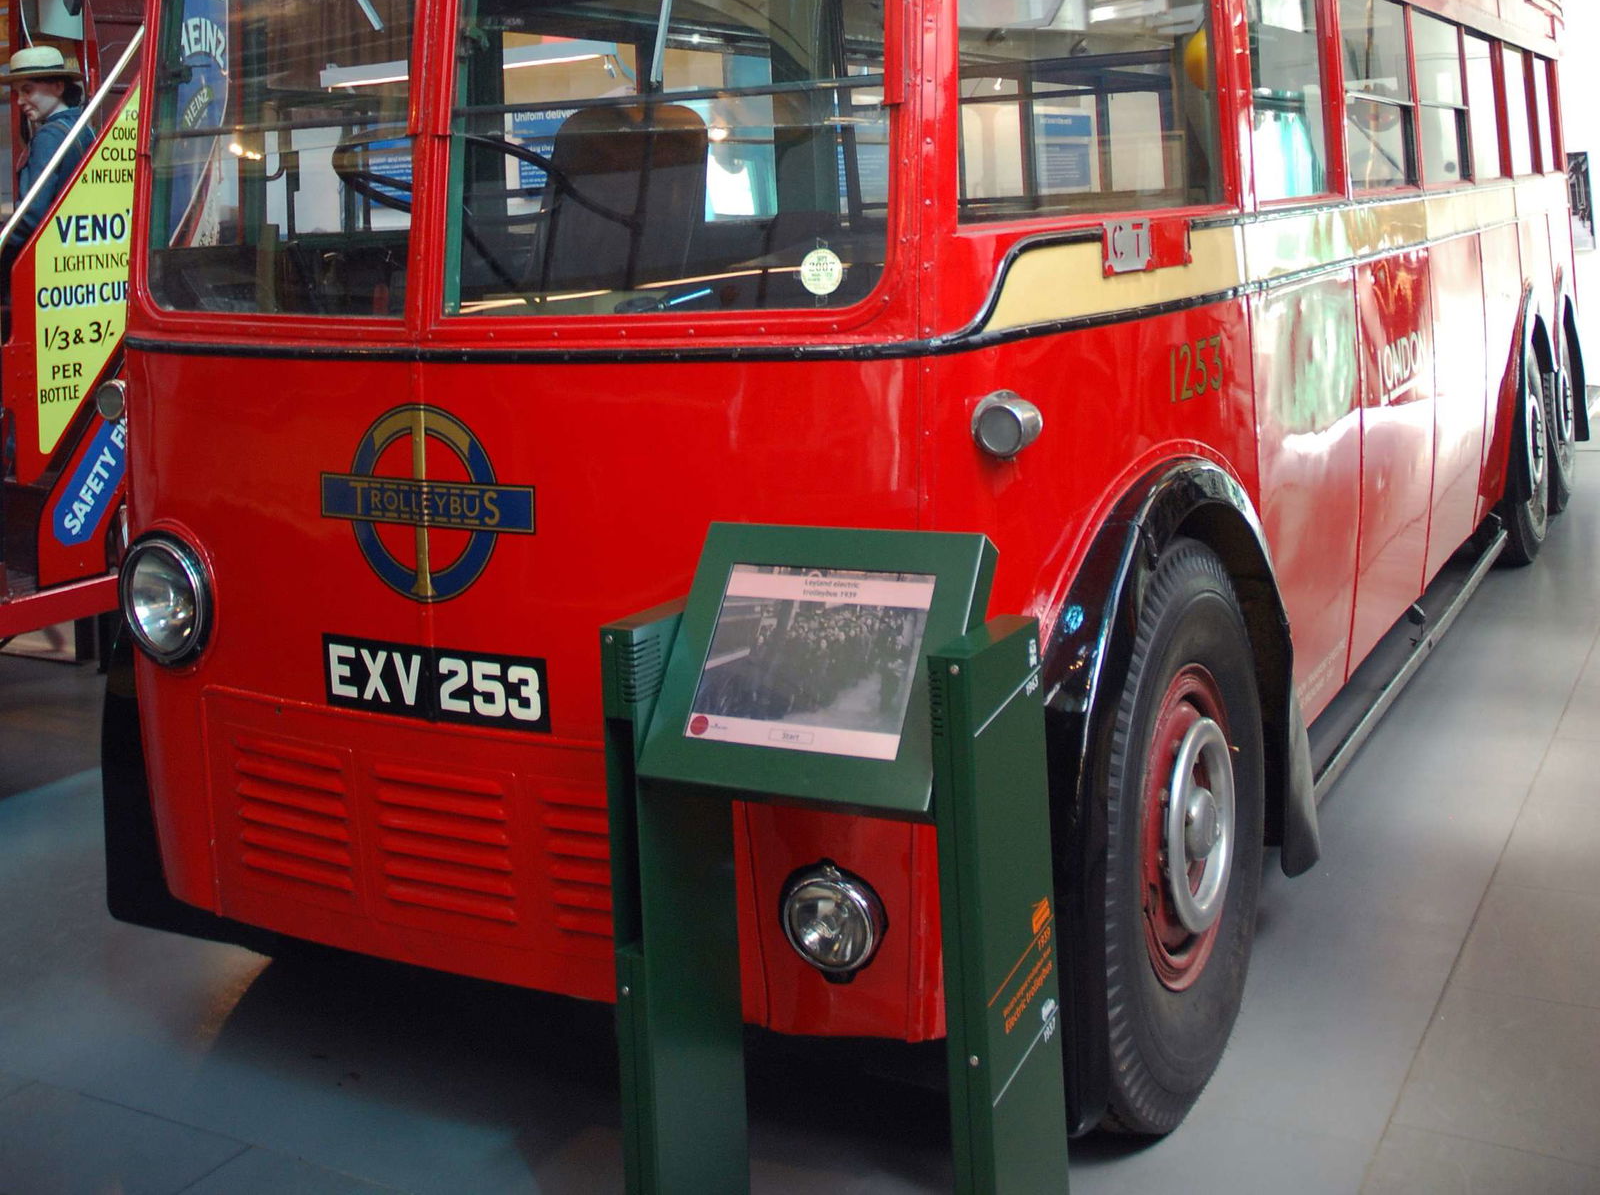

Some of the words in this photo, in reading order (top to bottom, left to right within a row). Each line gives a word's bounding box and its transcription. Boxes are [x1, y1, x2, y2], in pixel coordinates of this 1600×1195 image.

[185, 88, 209, 127] HEINZ
[514, 110, 544, 122] Uniform
[81, 173, 88, 184] &
[54, 251, 129, 273] LIGHTNING
[808, 261, 836, 272] 2007
[37, 283, 96, 308] COUGH
[72, 328, 85, 344] &
[51, 362, 83, 381] PER
[1170, 335, 1224, 404] 1253
[1377, 329, 1427, 403] LONDON
[39, 384, 80, 405] BOTTLE
[63, 446, 118, 536] SAFETY
[110, 418, 128, 451] FI
[349, 481, 500, 526] TROLLEYBUS
[328, 642, 422, 706] EXV
[438, 656, 542, 722] 253
